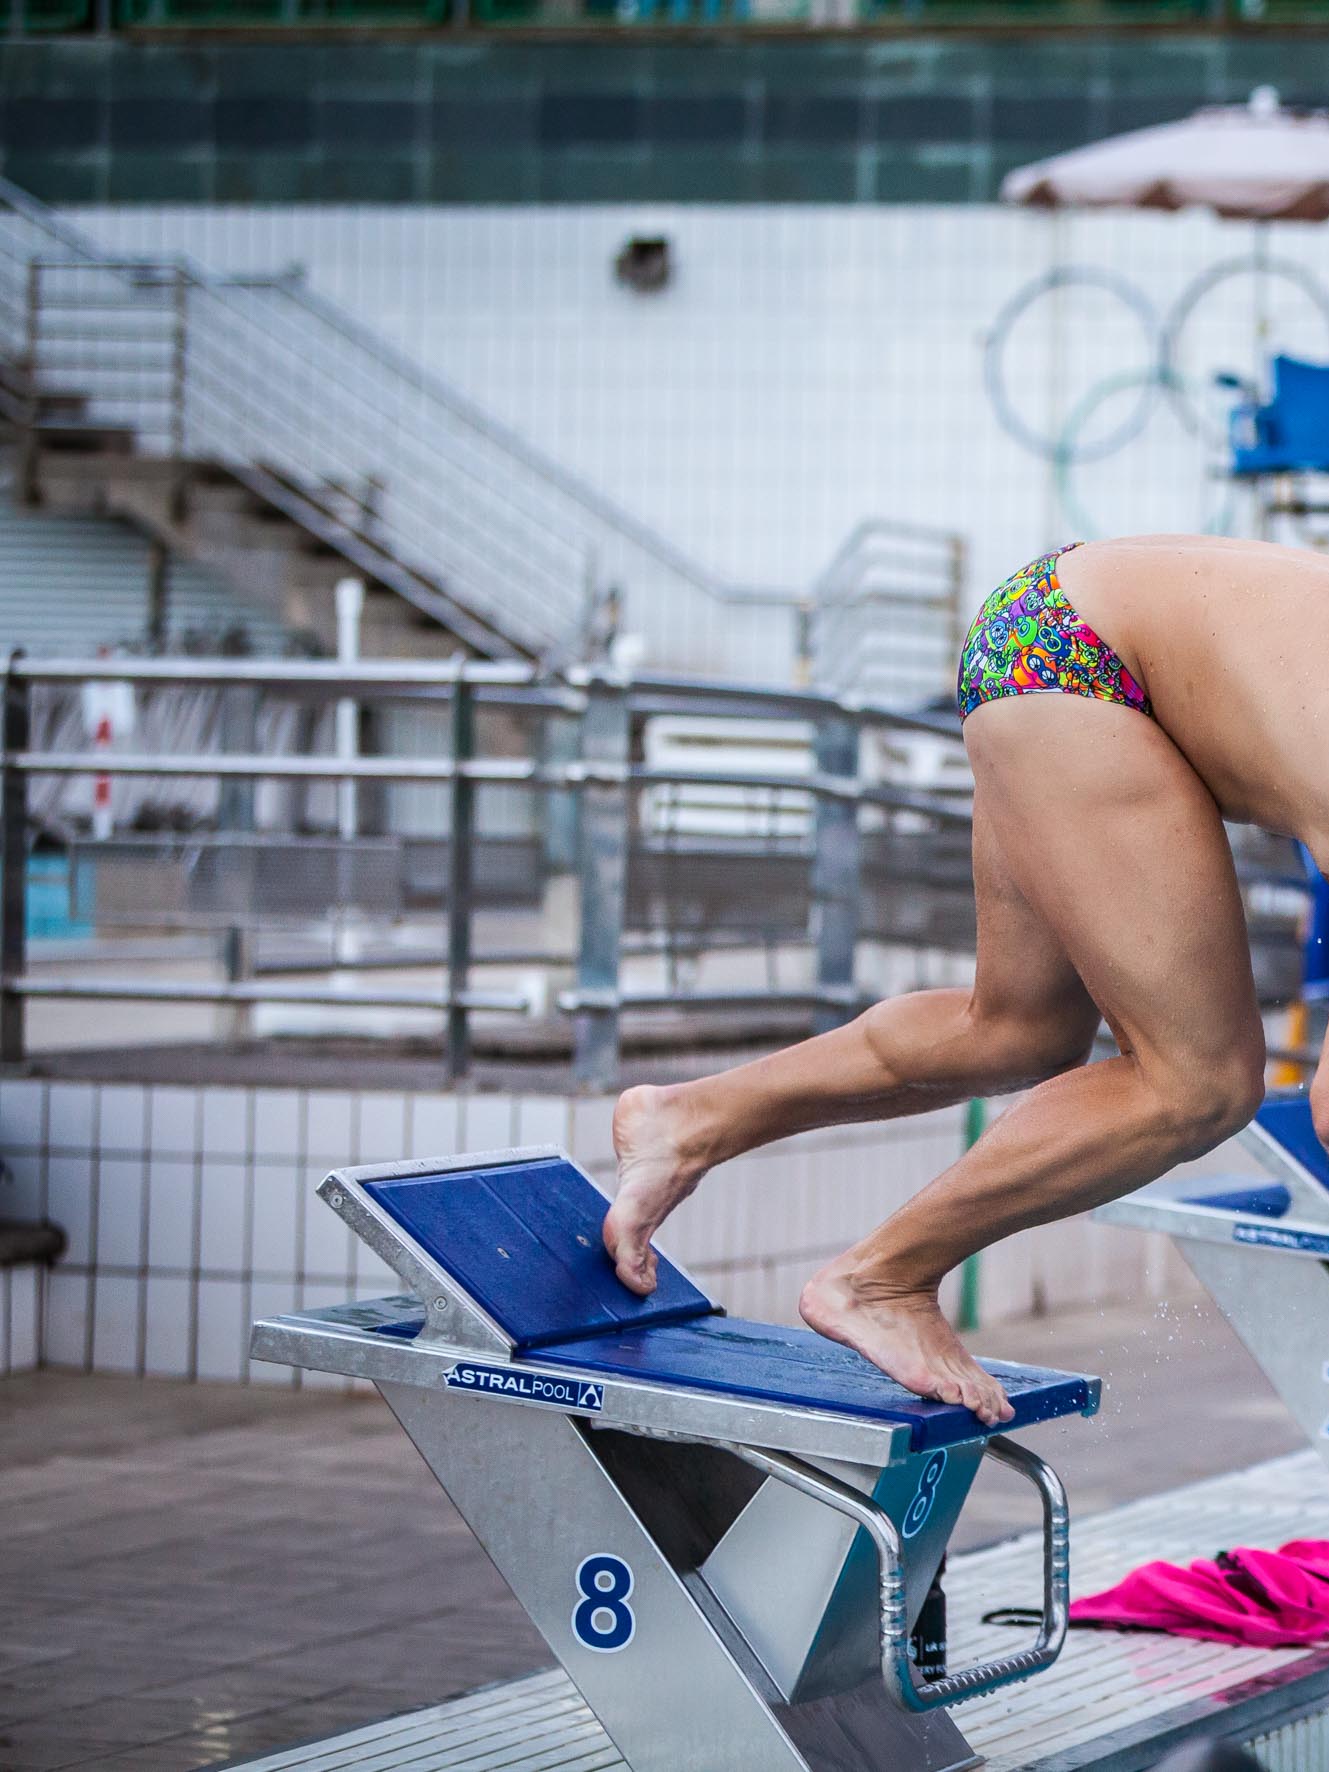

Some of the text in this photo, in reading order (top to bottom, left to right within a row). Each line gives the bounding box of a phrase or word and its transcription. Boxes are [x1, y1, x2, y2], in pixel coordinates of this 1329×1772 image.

[445, 1367, 575, 1402] ASTRALPOOL
[902, 1447, 948, 1539] 8
[572, 1553, 635, 1653] 8
